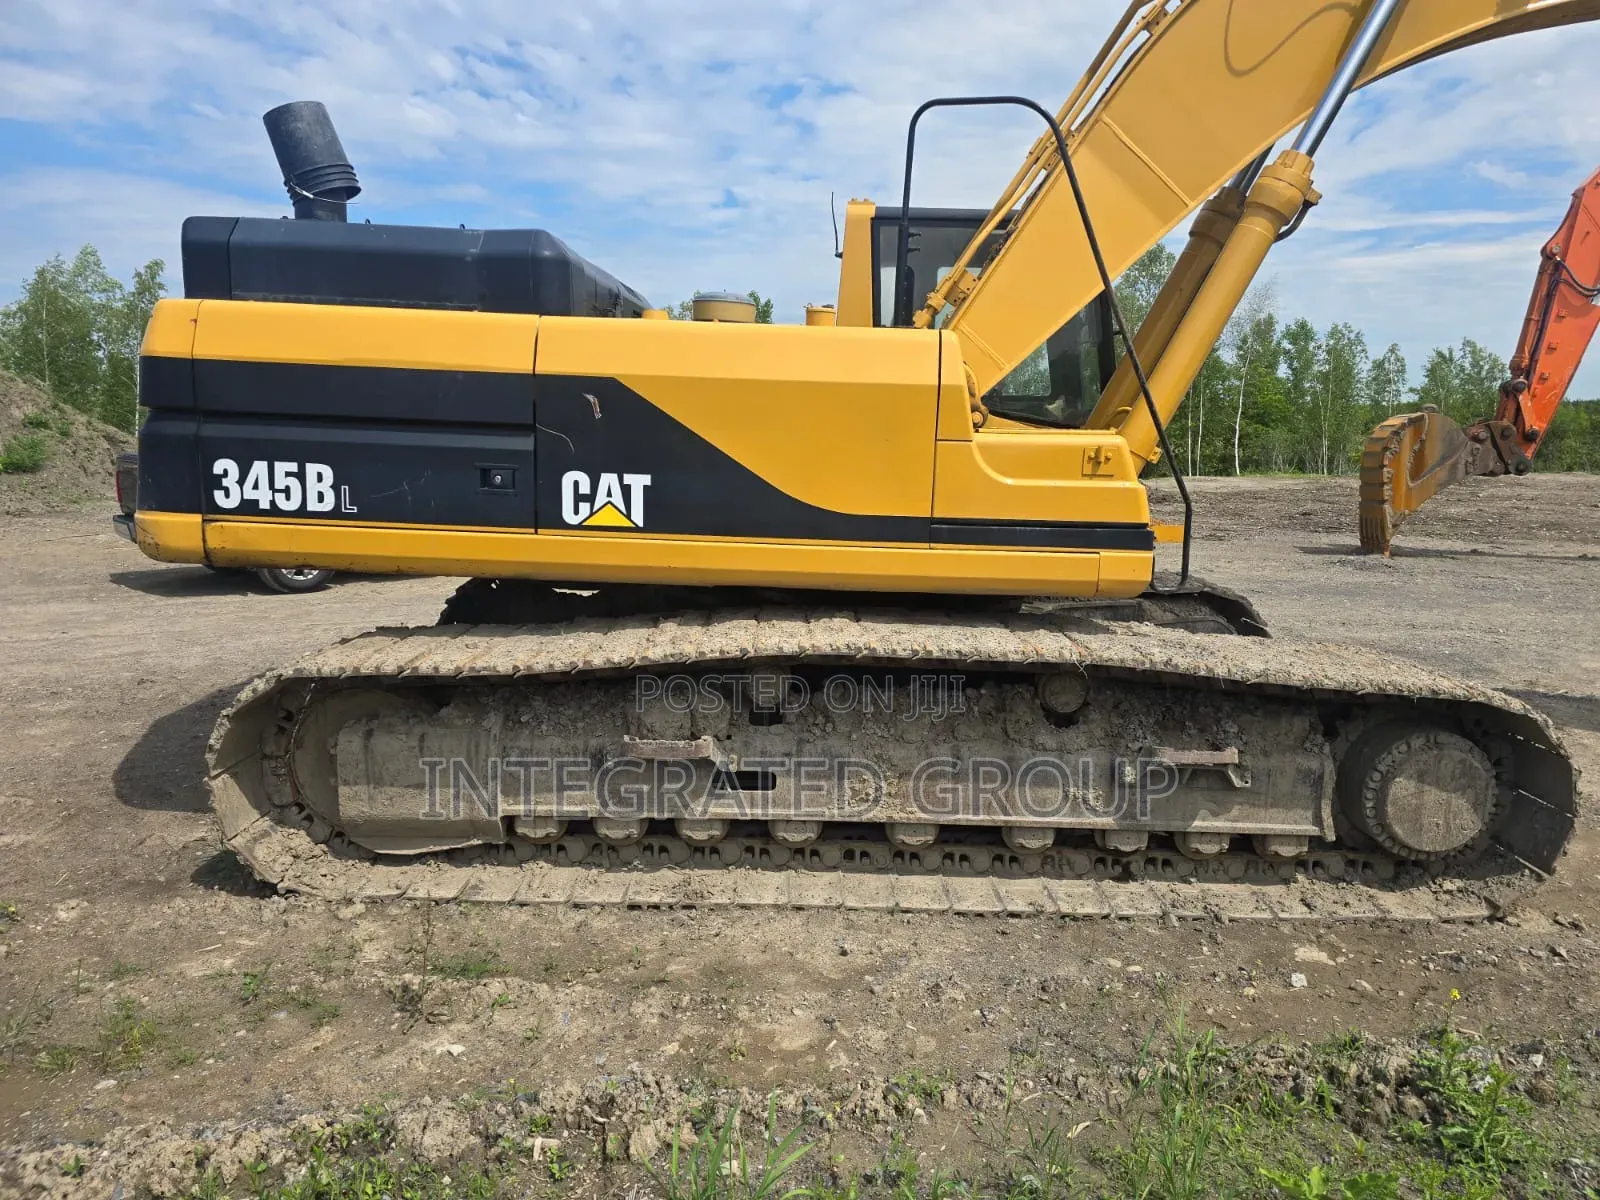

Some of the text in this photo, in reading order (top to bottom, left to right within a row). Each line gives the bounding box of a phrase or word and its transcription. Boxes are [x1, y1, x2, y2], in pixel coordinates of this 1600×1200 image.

[212, 458, 358, 513] 345B L
[561, 470, 652, 528] CAT
